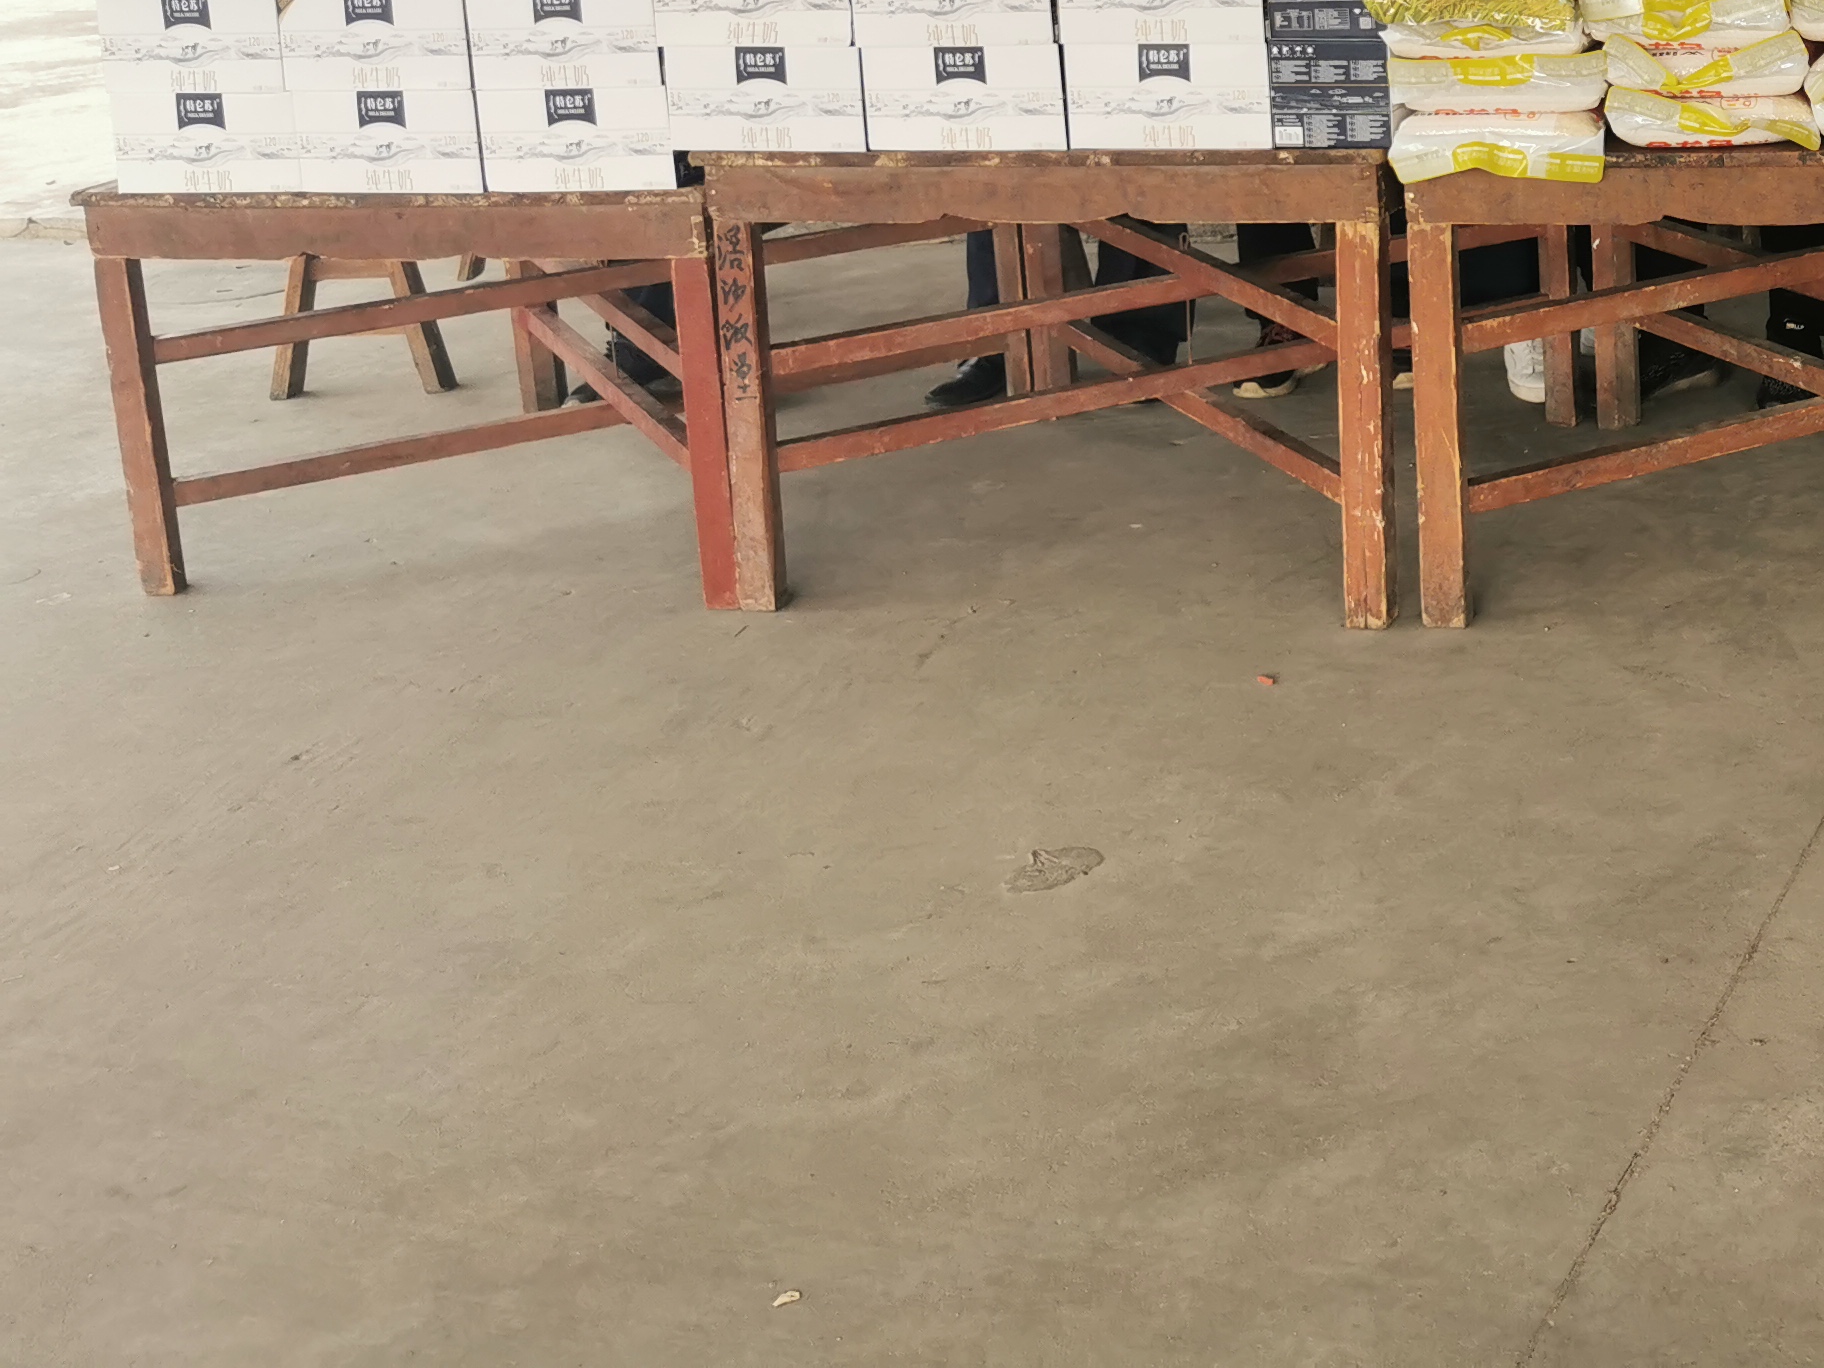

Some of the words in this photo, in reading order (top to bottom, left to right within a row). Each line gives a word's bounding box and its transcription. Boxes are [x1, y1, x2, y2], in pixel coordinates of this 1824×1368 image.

[728, 21, 778, 43] 纯牛奶
[927, 24, 977, 46] 纯牛奶
[1135, 18, 1187, 41] 纯牛奶
[171, 70, 218, 92] 纯牛奶
[351, 67, 398, 90] 纯牛奶
[540, 65, 588, 86] 纯牛奶
[741, 127, 791, 149] 纯牛奶
[942, 127, 992, 148] 纯牛奶
[1143, 125, 1194, 147] 纯牛奶
[185, 170, 232, 191] 纯牛奶
[365, 169, 412, 190] 纯牛奶
[555, 167, 603, 188] 纯牛奶
